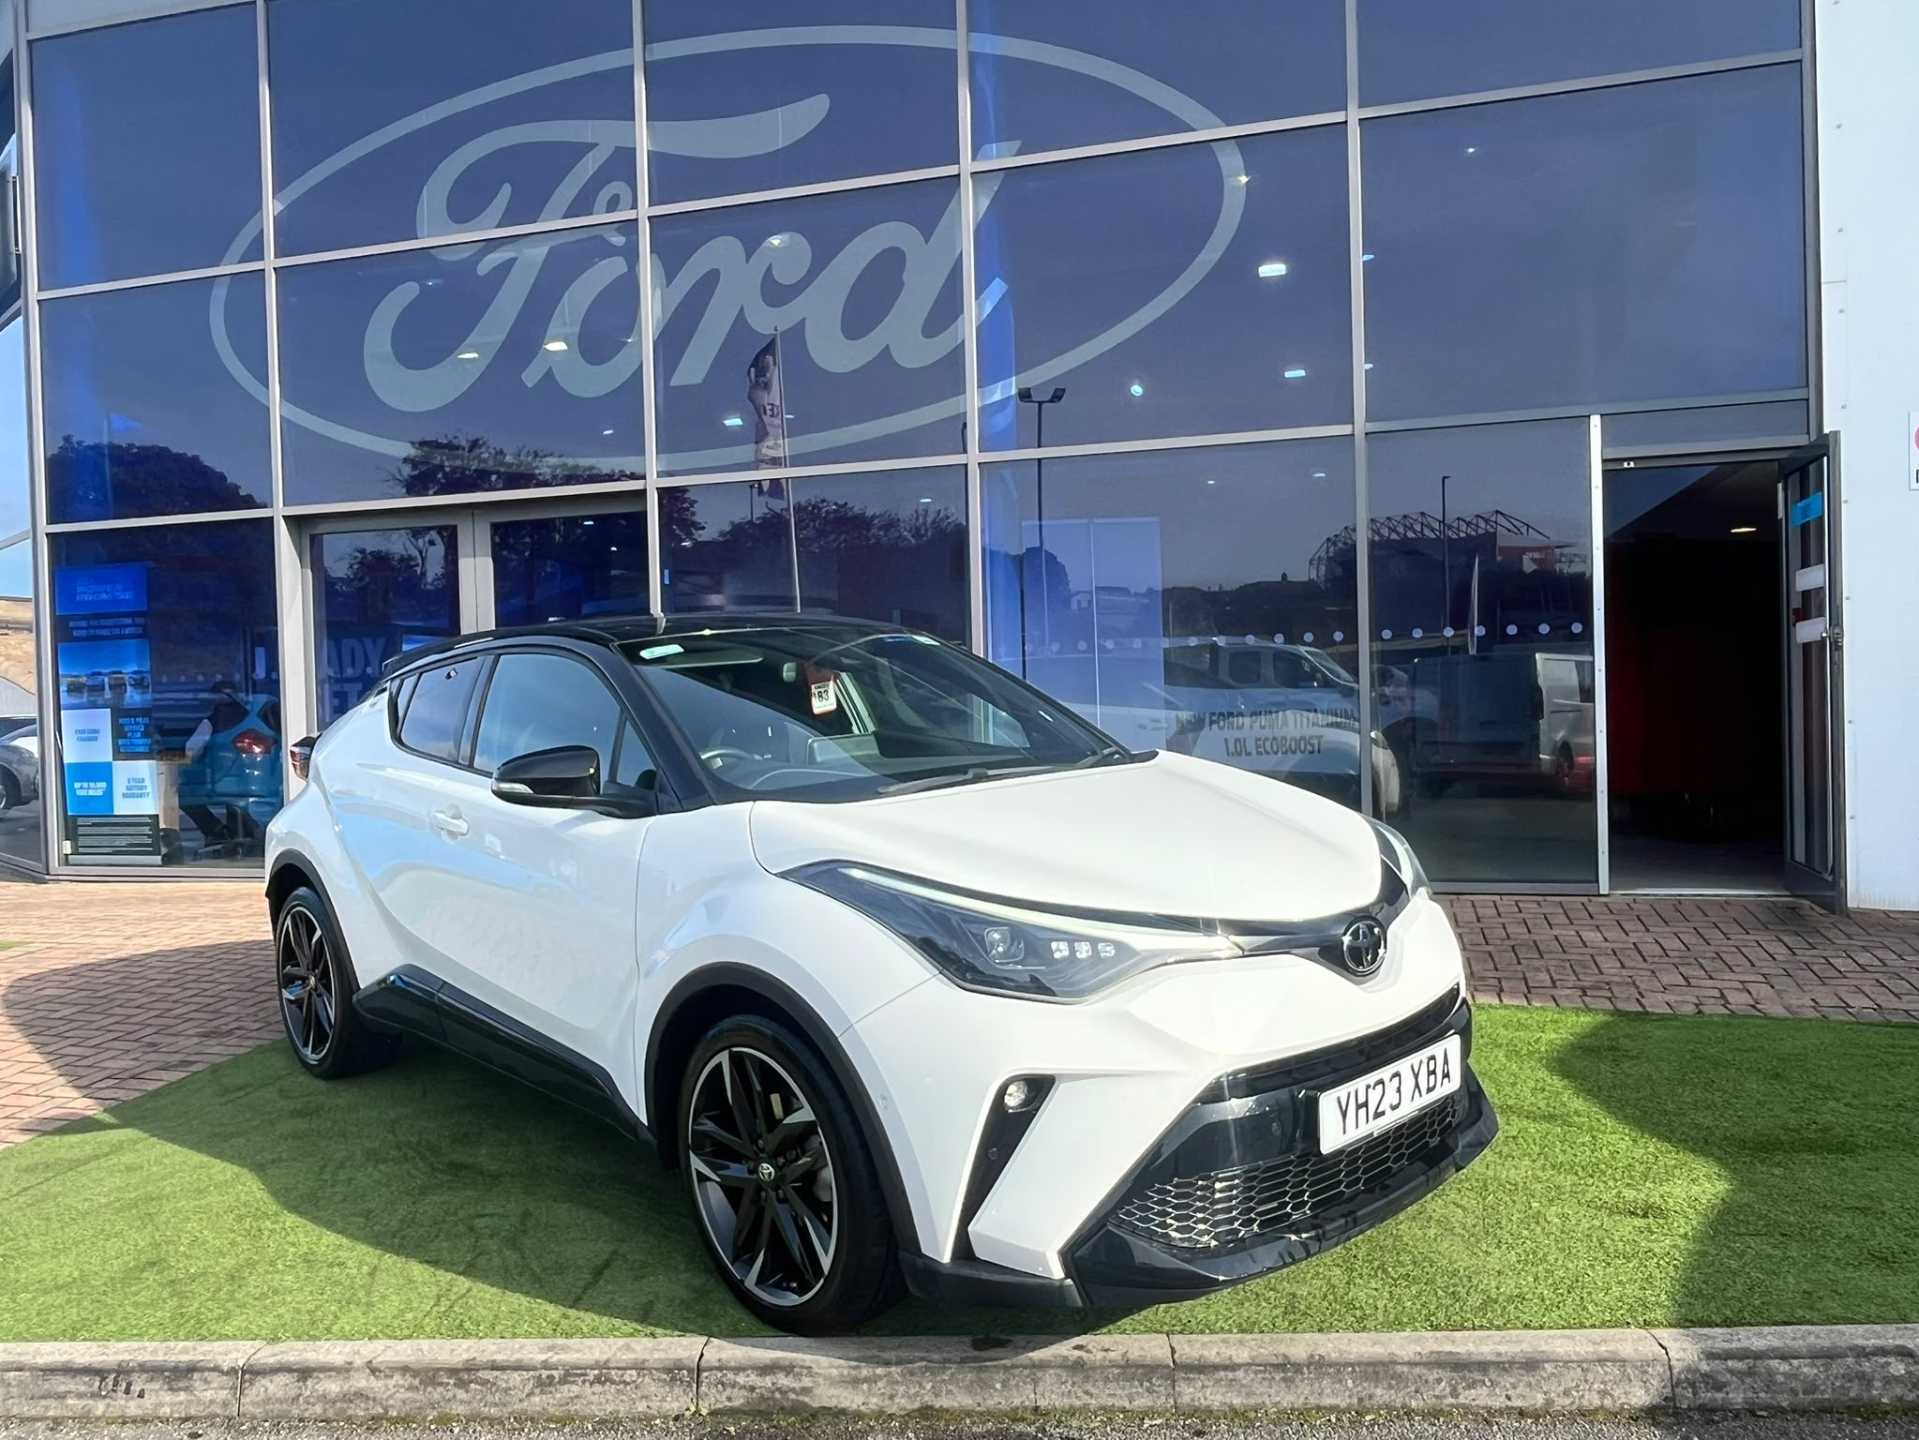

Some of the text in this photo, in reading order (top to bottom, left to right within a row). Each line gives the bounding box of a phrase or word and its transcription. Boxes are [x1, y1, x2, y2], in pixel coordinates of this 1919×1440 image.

[363, 93, 1022, 412] Ford
[1208, 710, 1246, 732] FORD
[1250, 708, 1288, 731] PUMA
[1223, 735, 1324, 758] 1.0L ECOBOOST
[1336, 1047, 1451, 1136] YH23 XBA
